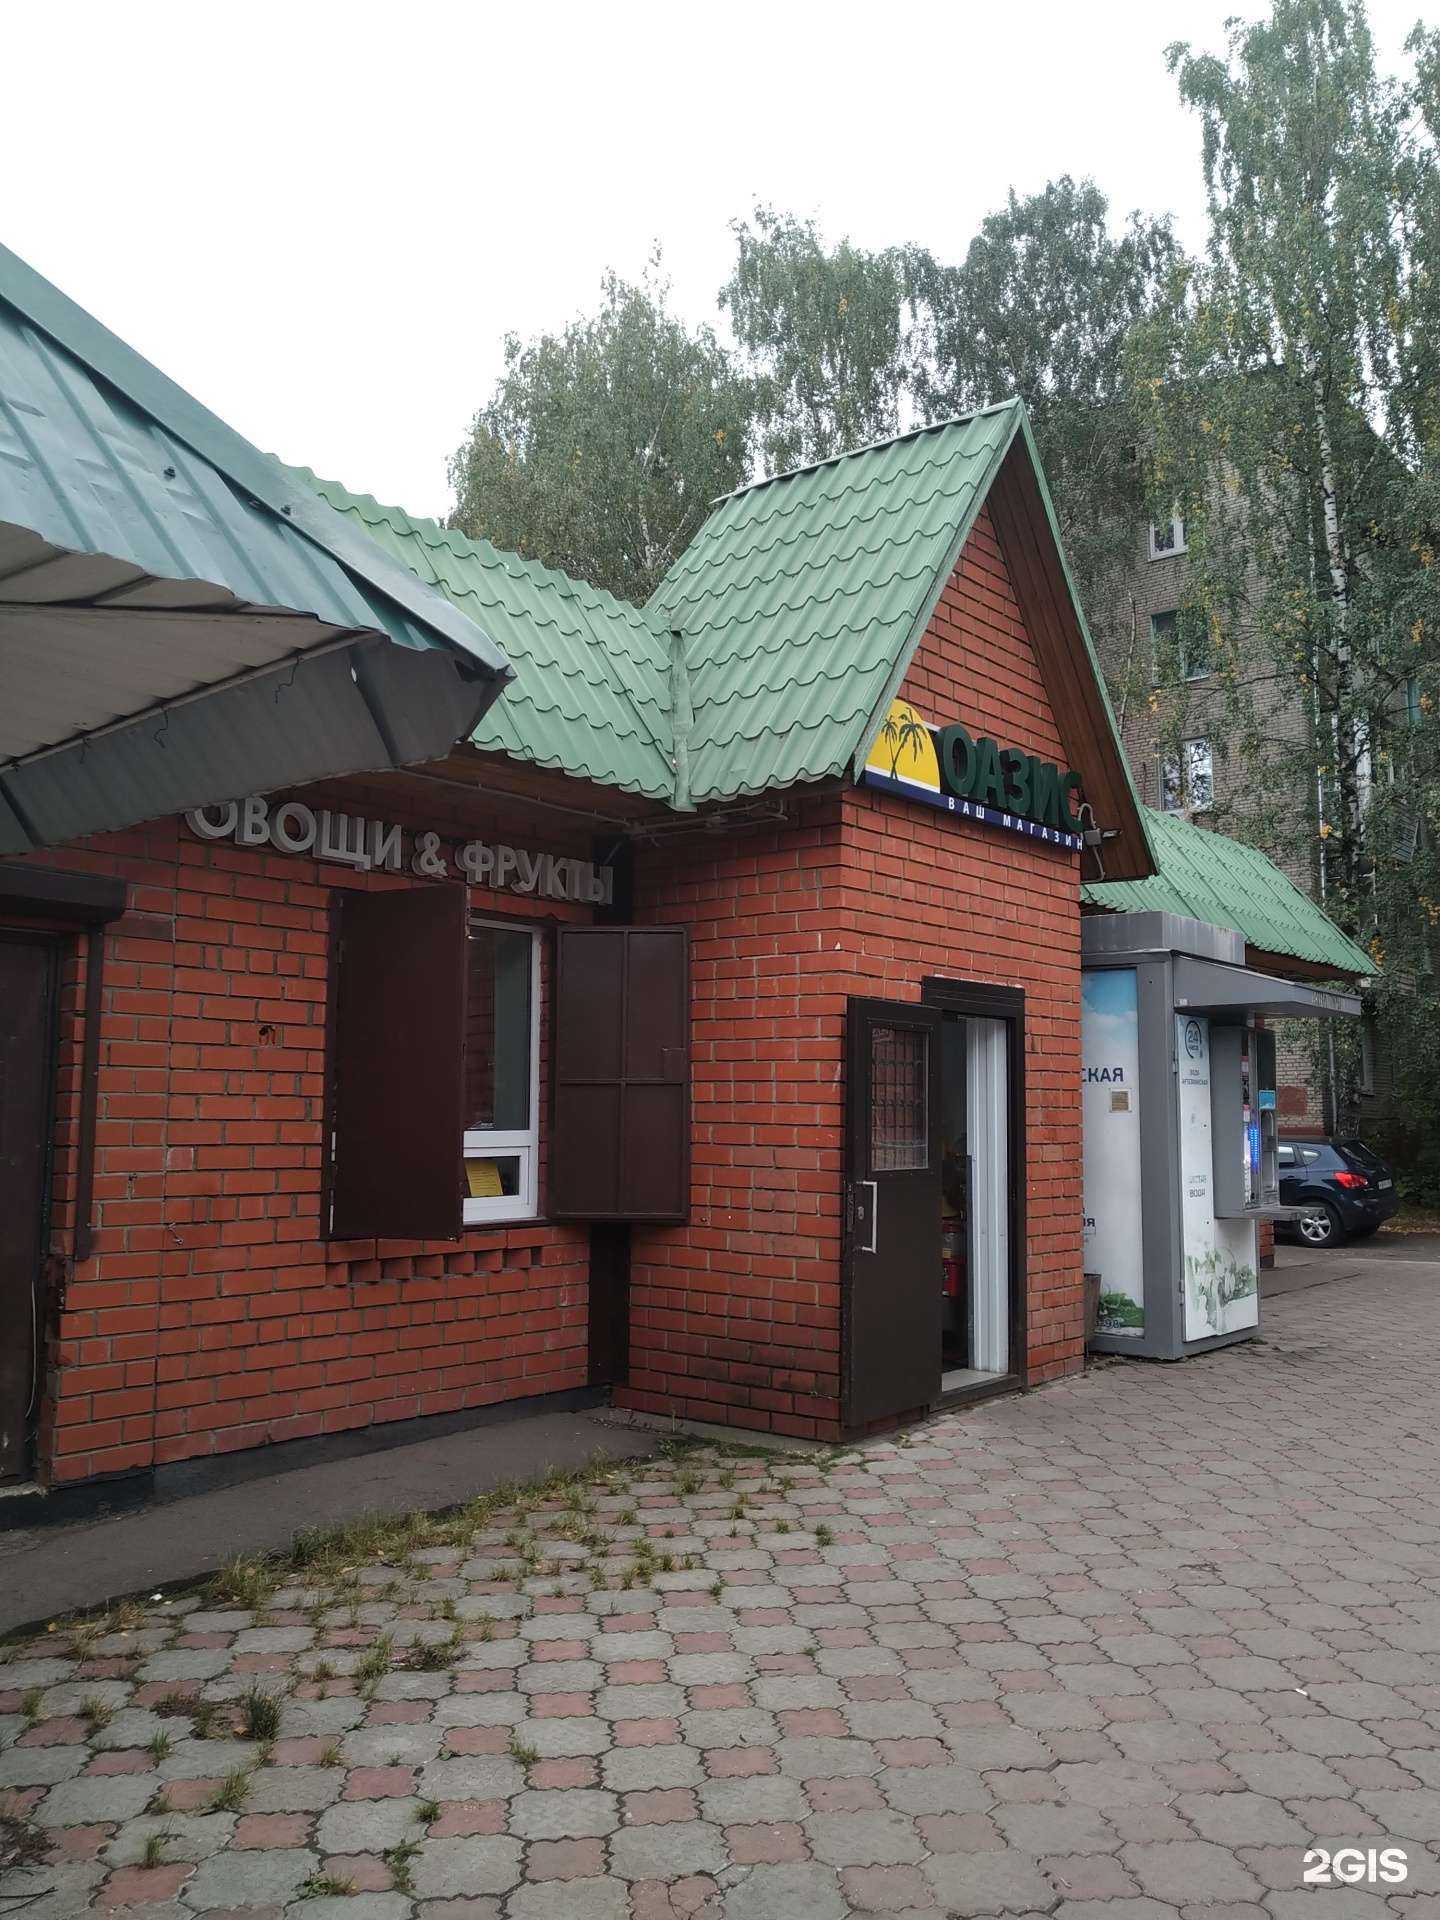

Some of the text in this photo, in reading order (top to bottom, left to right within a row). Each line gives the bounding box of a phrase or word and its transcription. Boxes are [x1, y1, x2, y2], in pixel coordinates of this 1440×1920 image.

[938, 724, 1083, 832] ОАЗИС
[948, 797, 1083, 850] ВАШ МАГАЗИН
[184, 798, 614, 904] ОВОЩИ & ФРУКТЫ
